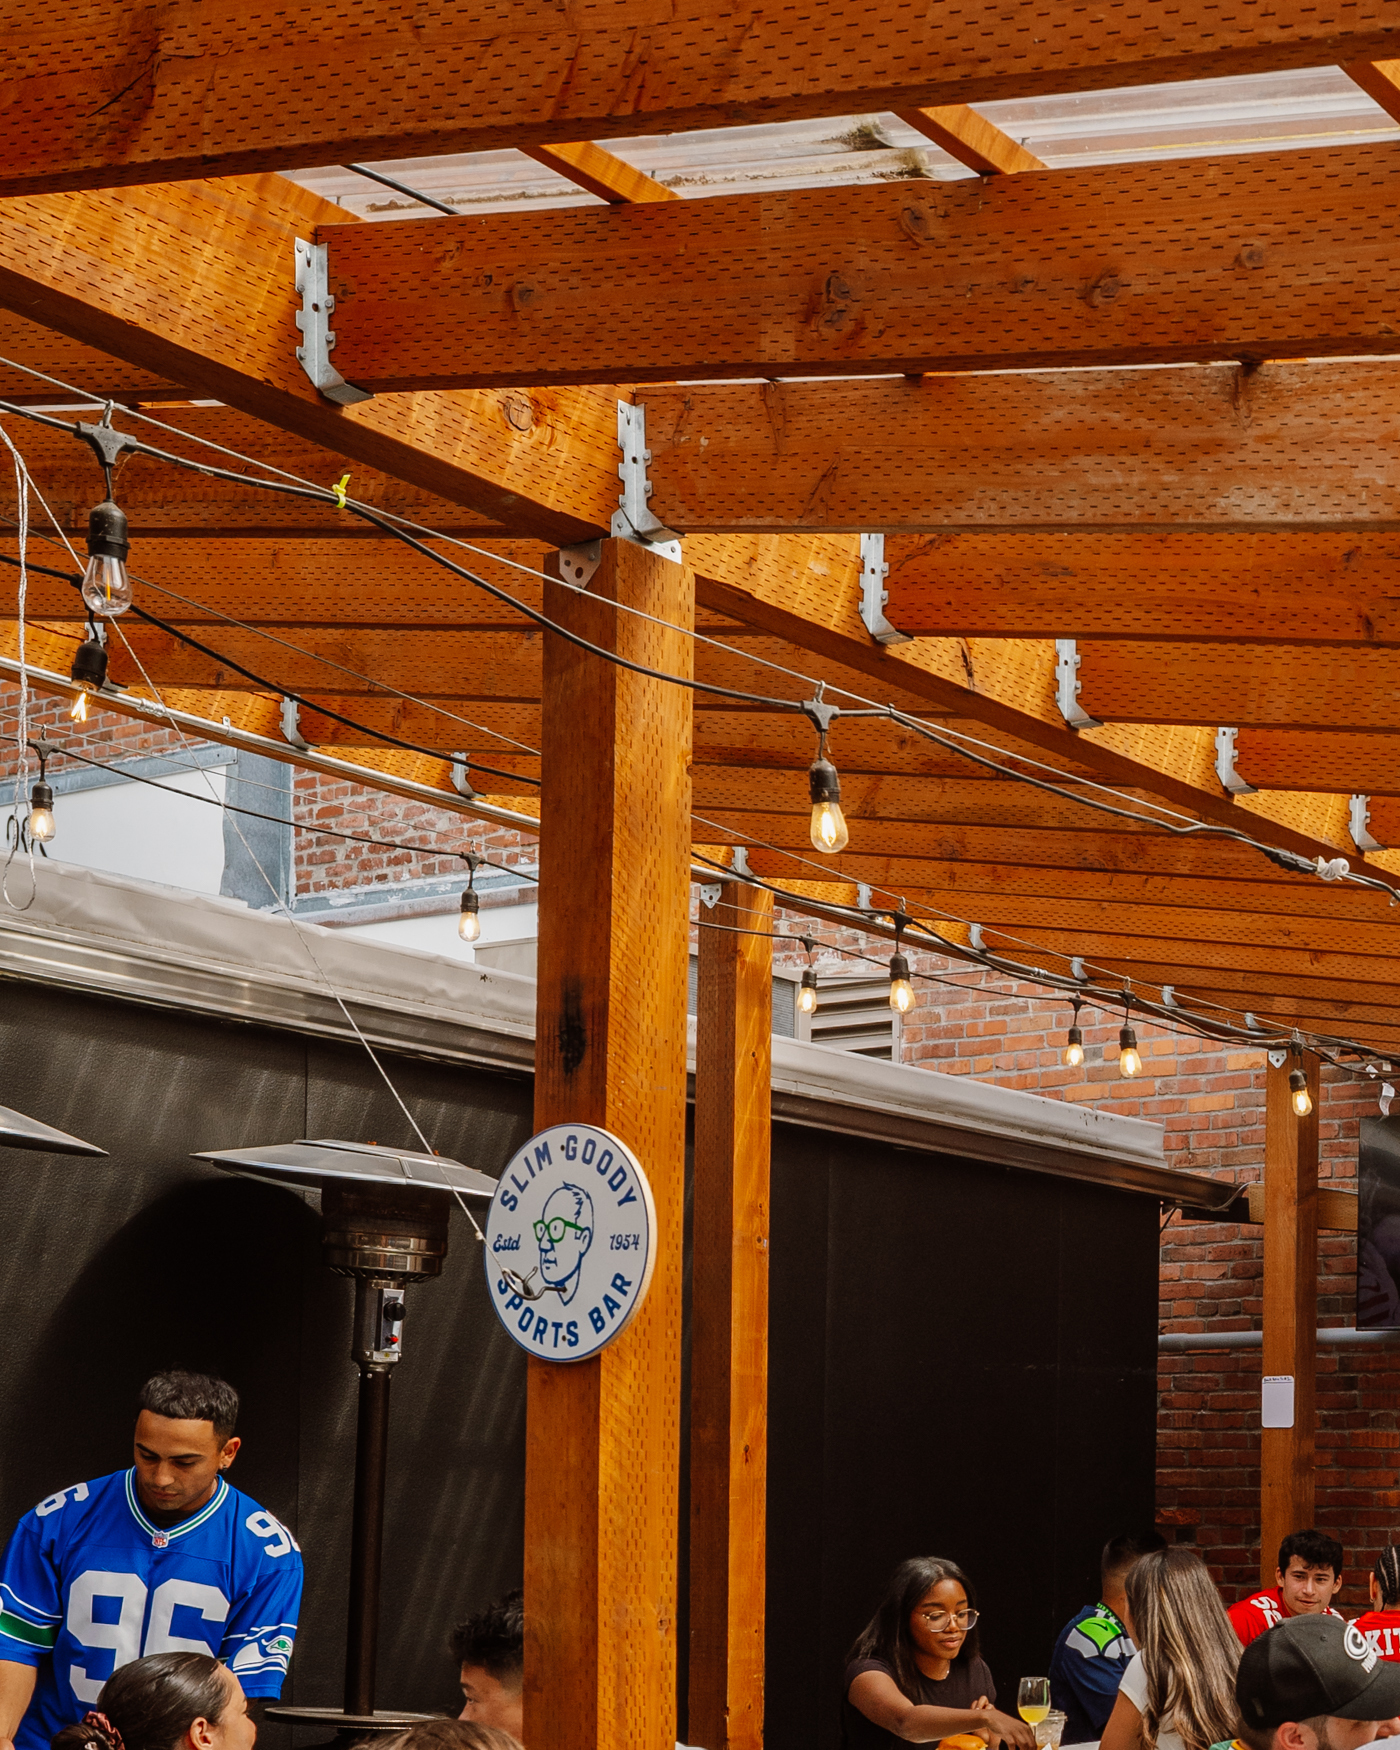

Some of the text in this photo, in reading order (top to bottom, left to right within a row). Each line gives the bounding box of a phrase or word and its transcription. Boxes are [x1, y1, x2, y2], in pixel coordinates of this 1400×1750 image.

[500, 1135, 637, 1212] SLIM GOODY
[493, 1234, 520, 1252] Estd
[609, 1234, 640, 1250] 1954
[497, 1272, 632, 1348] SPORTS BAR
